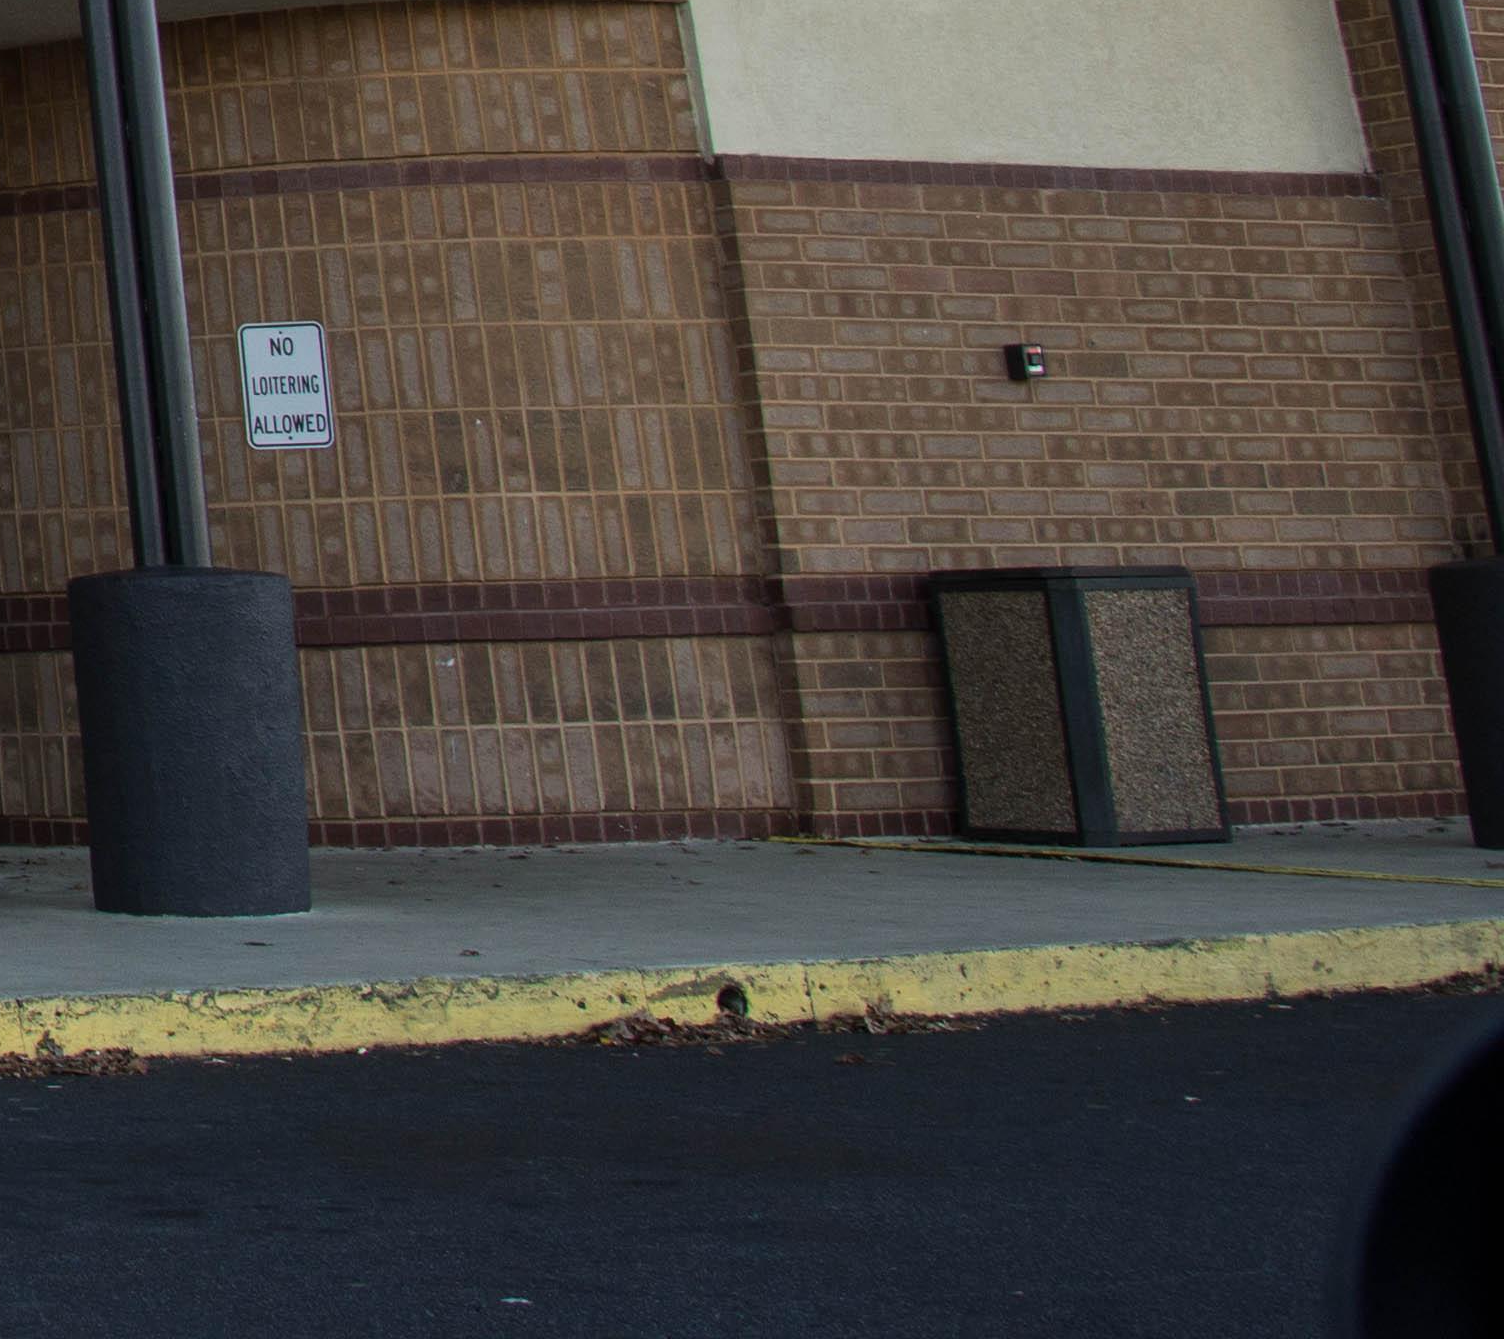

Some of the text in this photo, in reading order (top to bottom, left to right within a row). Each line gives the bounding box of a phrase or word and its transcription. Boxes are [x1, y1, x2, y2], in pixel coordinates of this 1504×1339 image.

[269, 337, 294, 356] NO
[252, 375, 319, 396] LOITERING
[254, 414, 326, 434] ALLOWED
